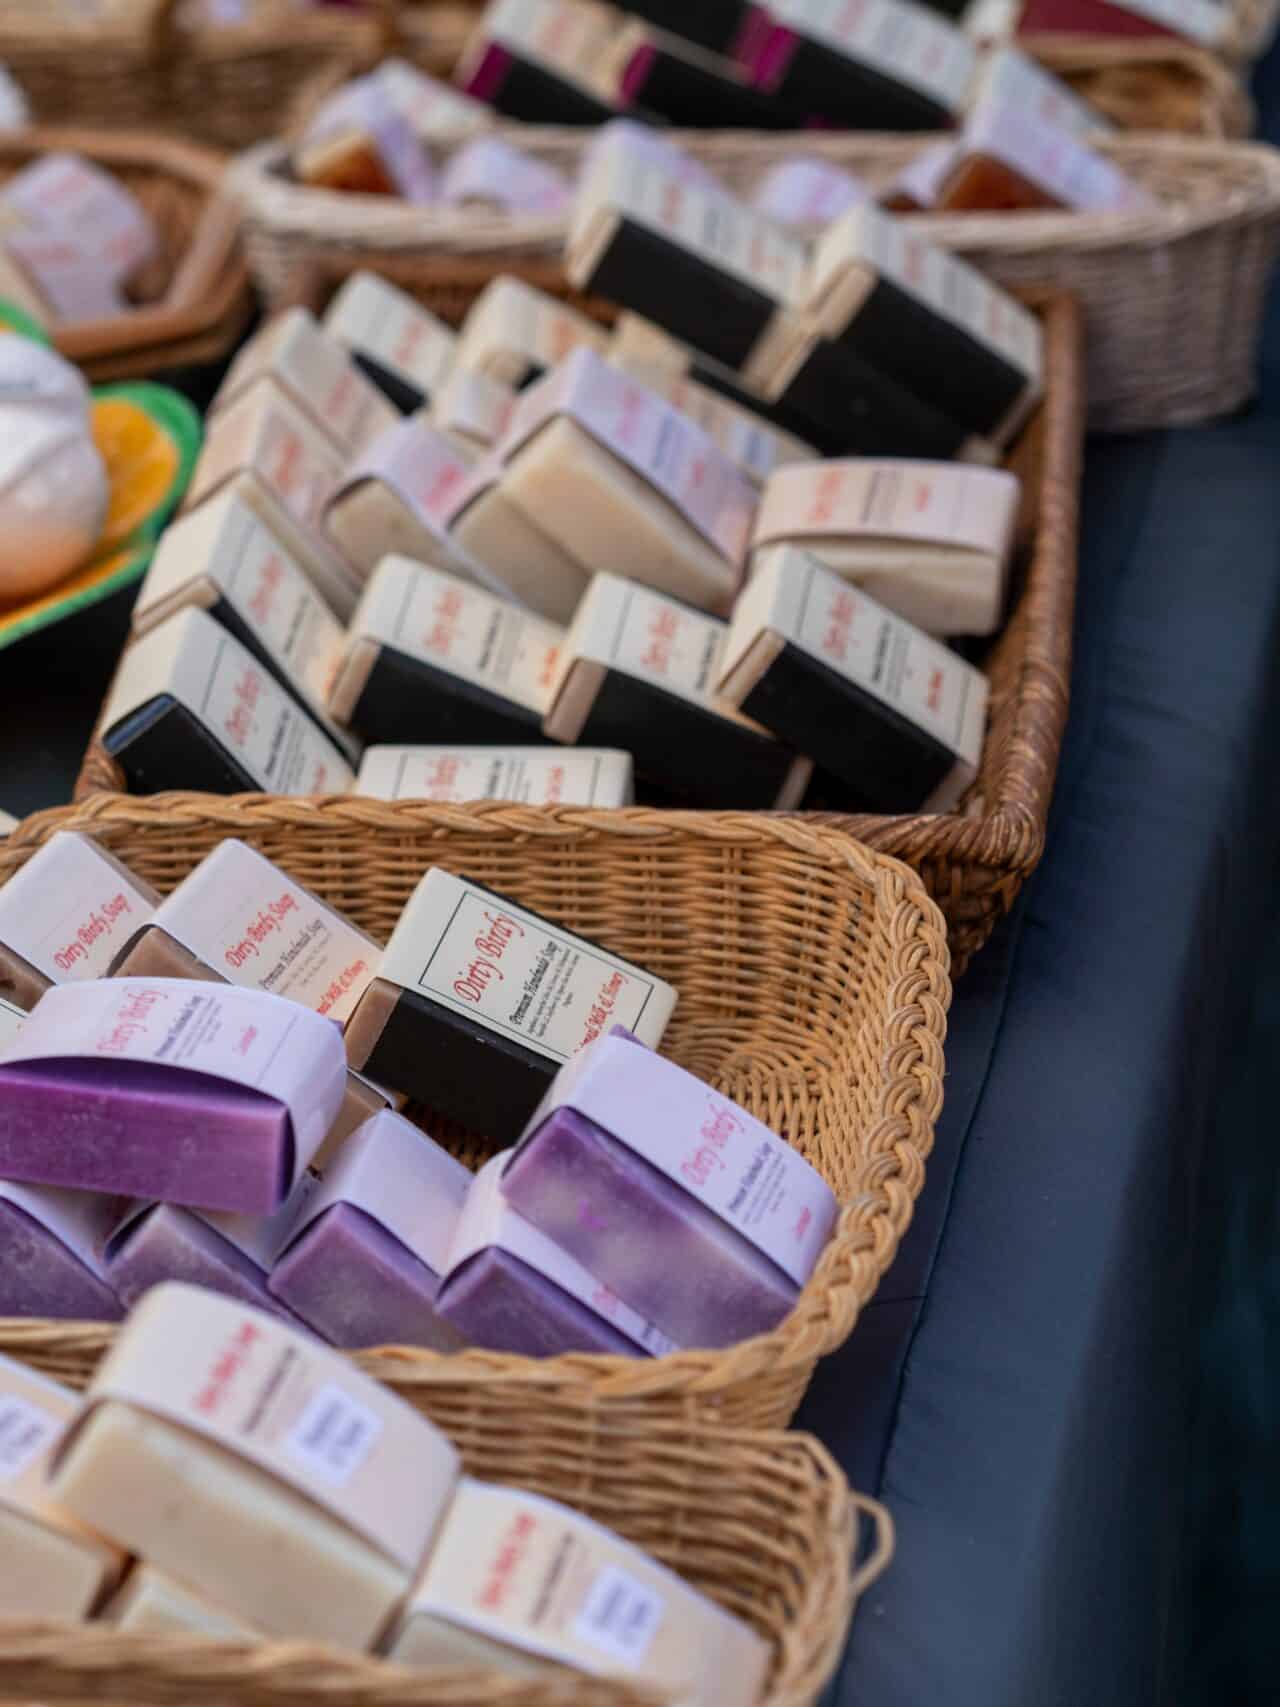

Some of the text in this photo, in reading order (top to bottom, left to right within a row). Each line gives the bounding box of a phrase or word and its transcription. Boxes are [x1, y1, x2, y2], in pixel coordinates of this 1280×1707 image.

[54, 893, 131, 970] Dirty Birdy Soap
[225, 894, 299, 968] Dirty Birdy Soap
[454, 911, 524, 1003] Dirty Birdy
[509, 994, 532, 1025] Premium
[523, 956, 549, 996] Handmade
[540, 941, 562, 960] Soap
